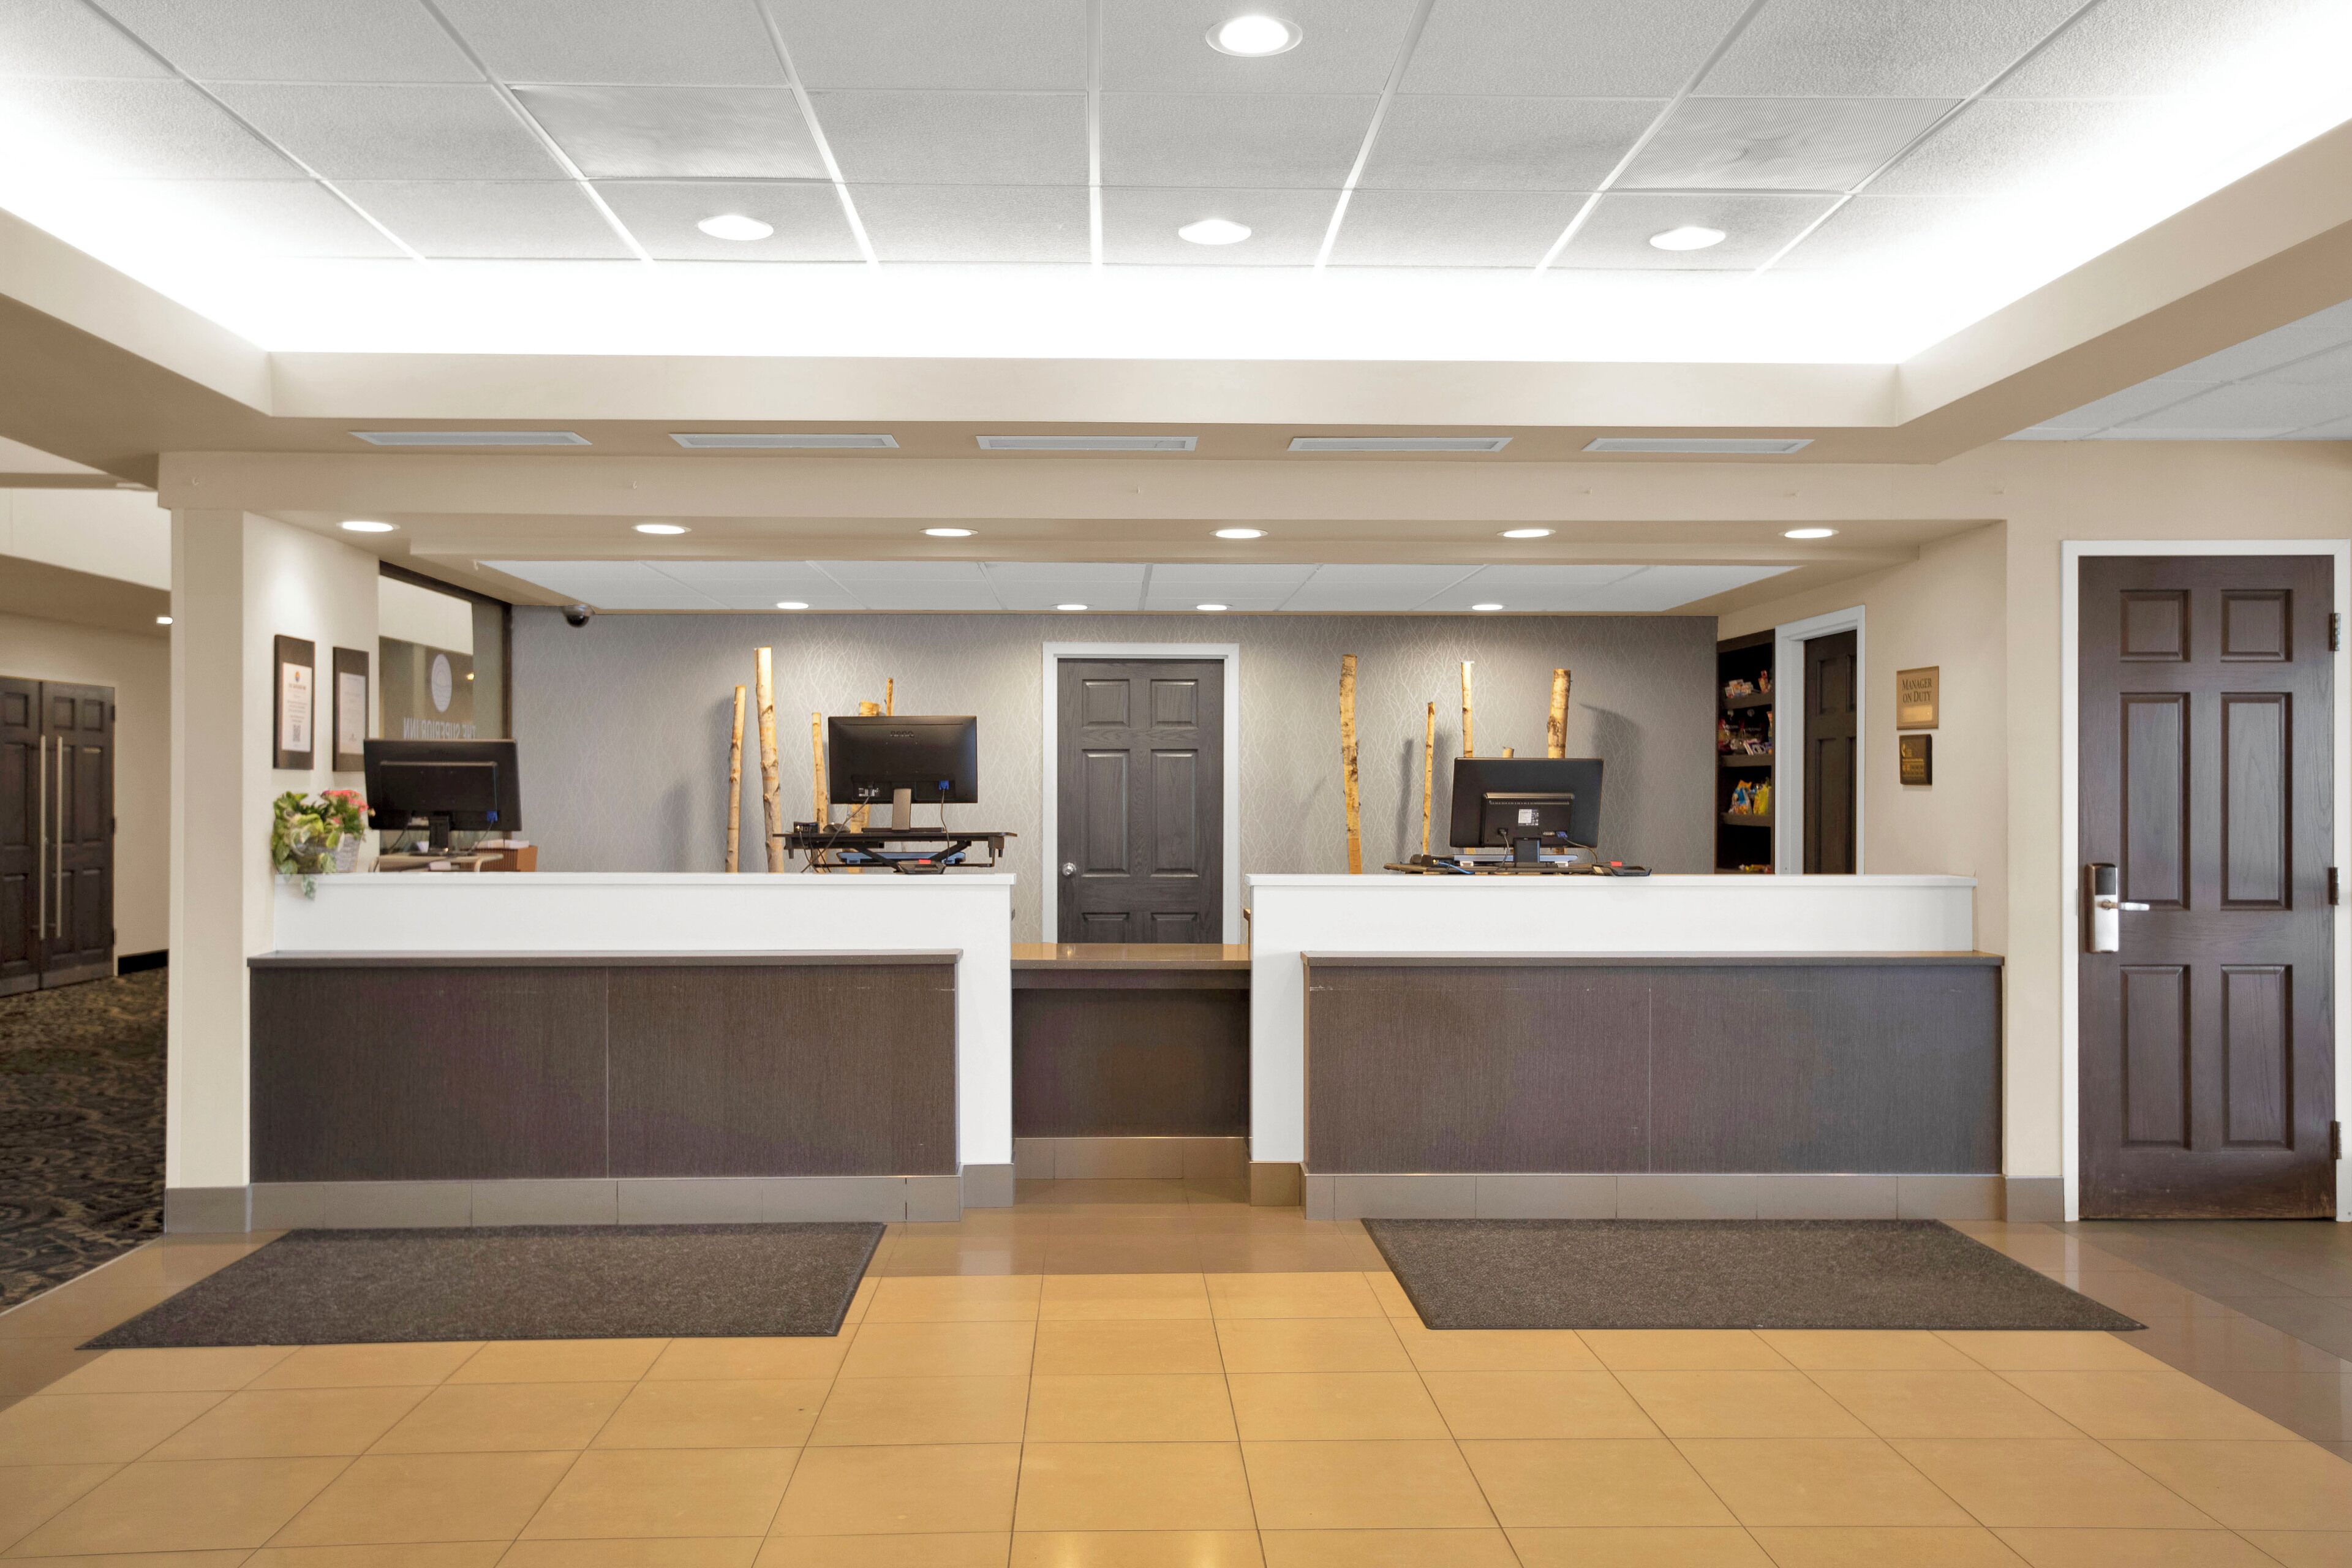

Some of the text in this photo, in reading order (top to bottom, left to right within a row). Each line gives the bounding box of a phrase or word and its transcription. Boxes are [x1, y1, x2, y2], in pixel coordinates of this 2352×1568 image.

[1902, 678, 1932, 690] MANAGER
[1902, 690, 1932, 703] ON DUTY
